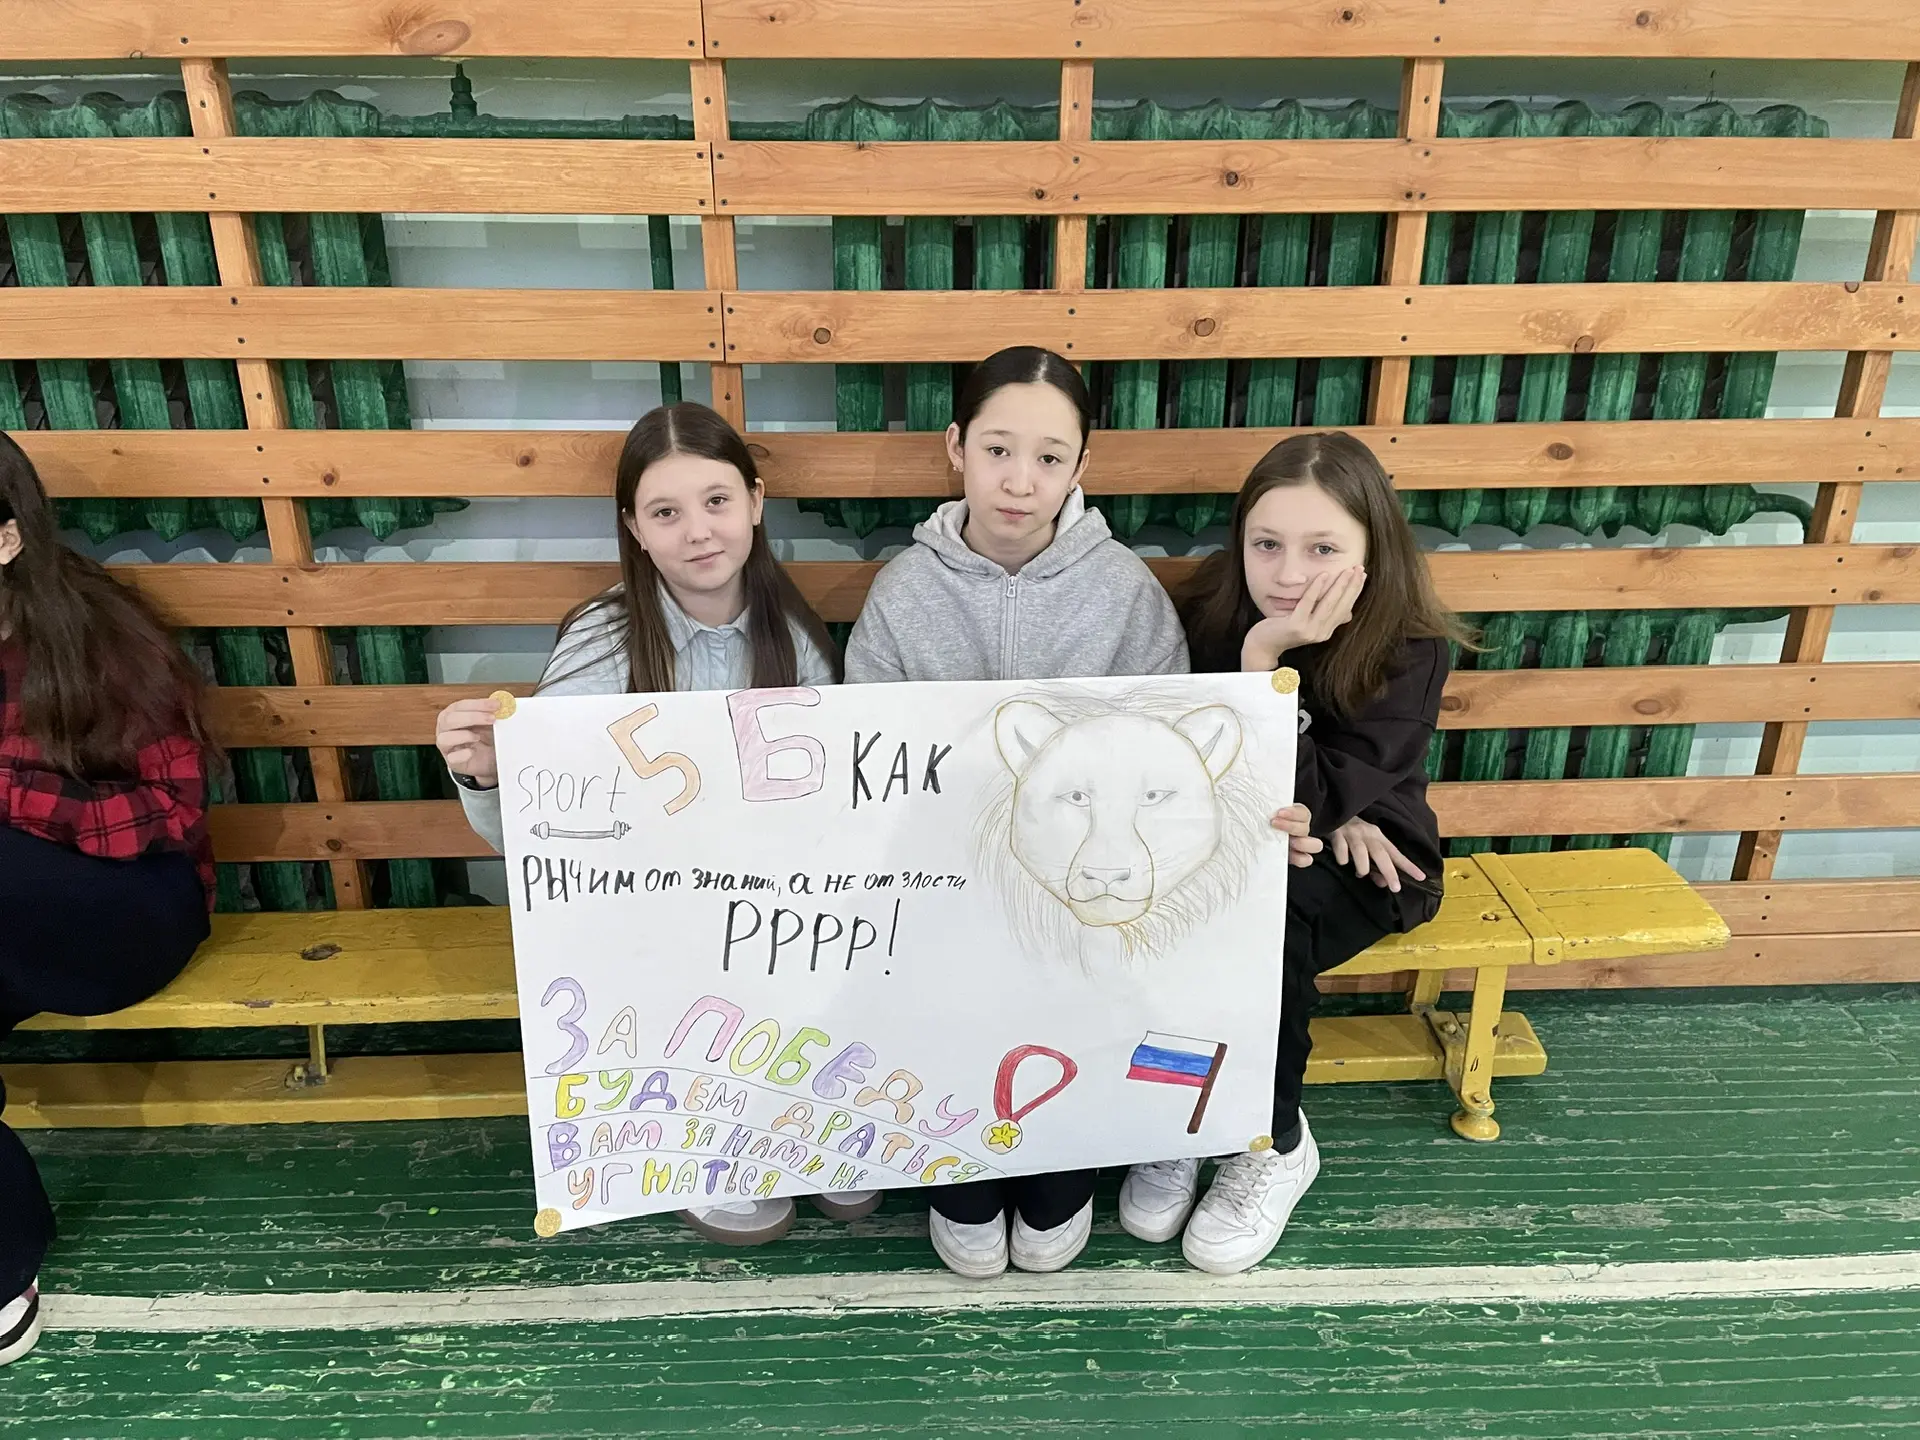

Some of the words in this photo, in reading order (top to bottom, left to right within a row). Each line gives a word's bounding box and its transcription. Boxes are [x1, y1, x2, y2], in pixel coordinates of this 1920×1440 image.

[606, 703, 702, 816] 5
[726, 687, 827, 802] Б
[852, 731, 953, 809] КАК
[541, 977, 637, 1075] ЗА
[664, 995, 979, 1137] ПОБЕДУ
[547, 1122, 662, 1172] ВАМ
[681, 1118, 717, 1149] ЗА
[720, 1124, 826, 1177] НАМИ
[555, 1069, 748, 1119] БУДЕМ
[771, 1101, 989, 1184] ДРАТЬСЯ
